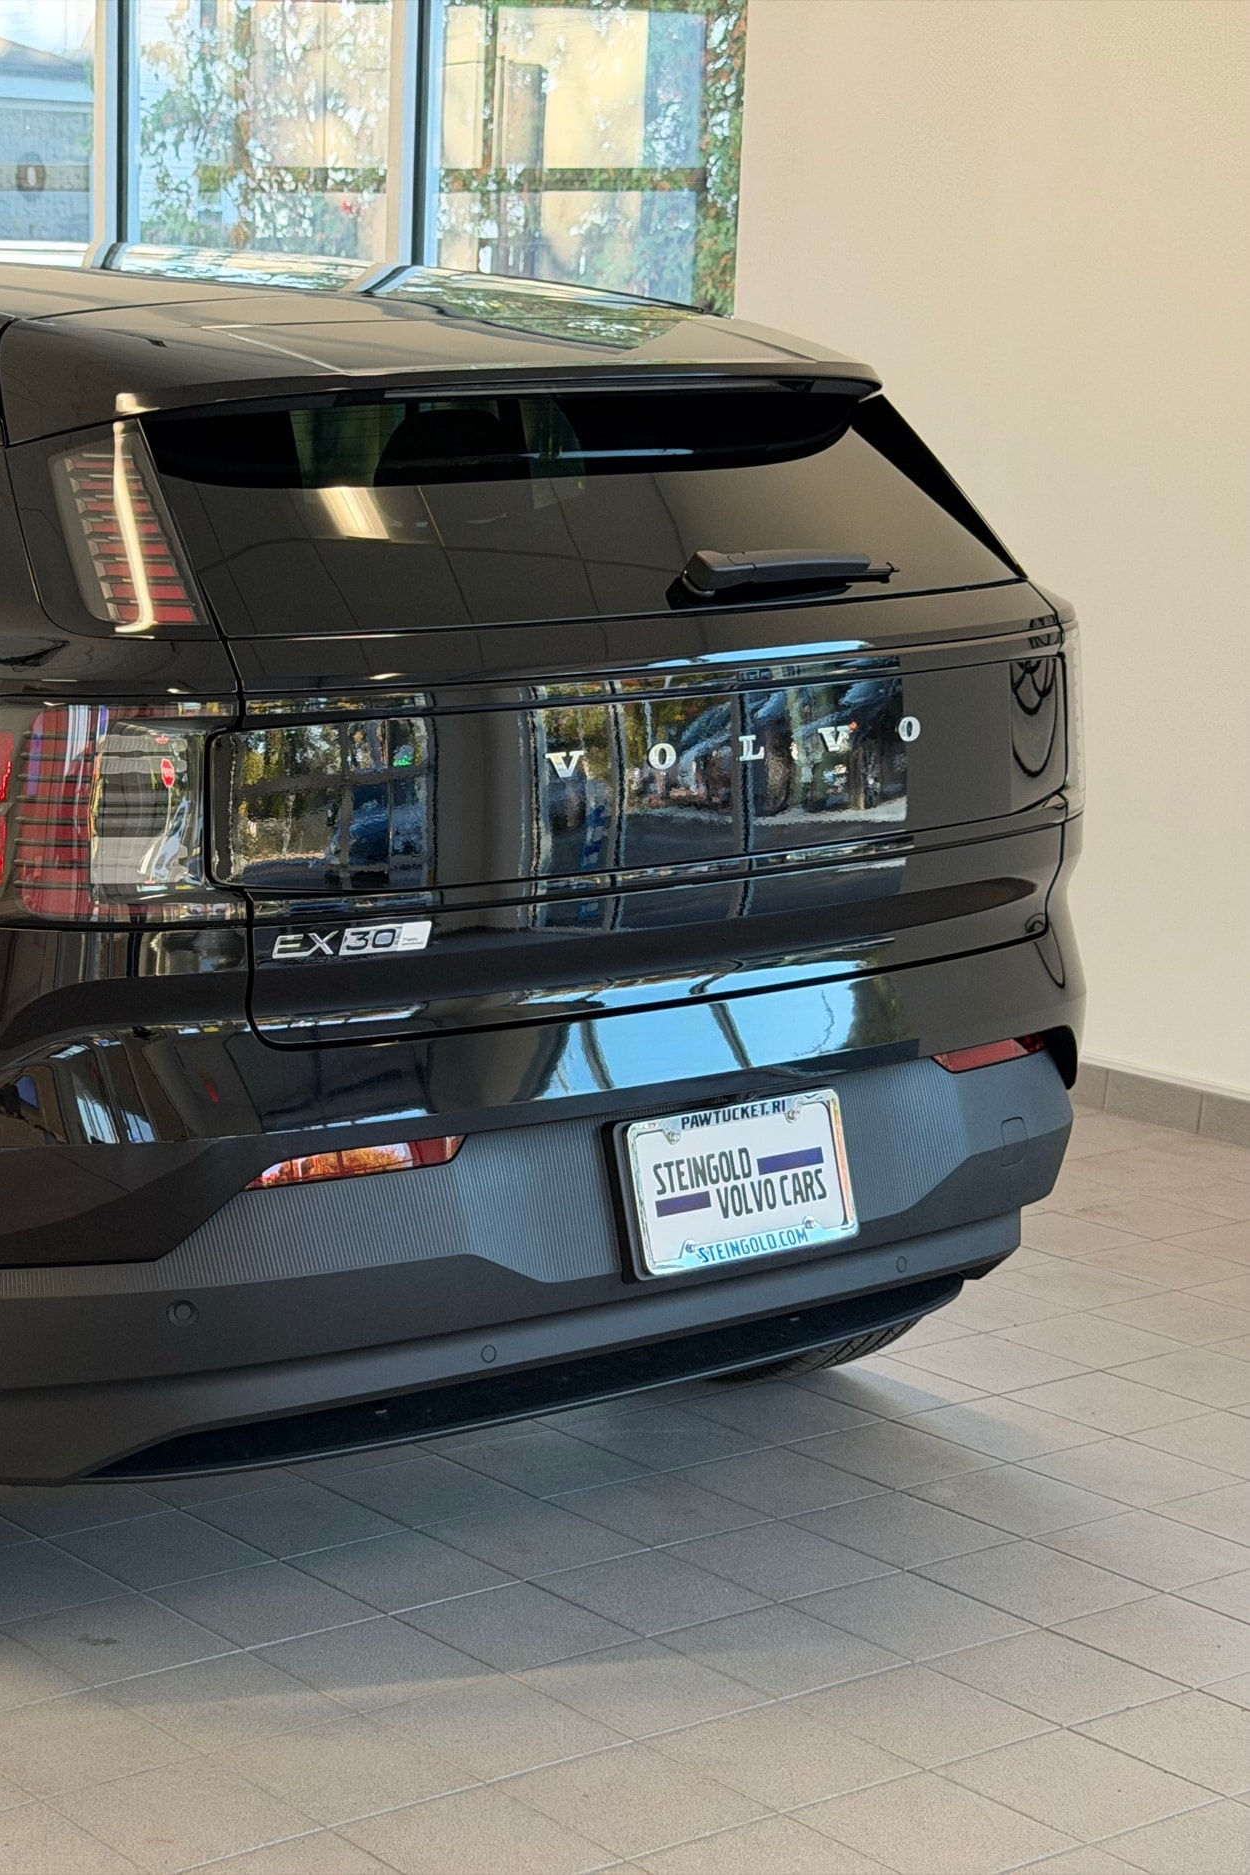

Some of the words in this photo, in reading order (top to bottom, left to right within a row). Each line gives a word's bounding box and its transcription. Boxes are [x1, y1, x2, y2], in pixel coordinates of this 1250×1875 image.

[545, 716, 921, 778] VOLVO
[772, 1099, 786, 1114] RI
[652, 1147, 752, 1195] STEINGOLD
[716, 1178, 777, 1219] VOLVO
[779, 1168, 827, 1206] CARS
[699, 1228, 809, 1264] STEINGOLD.COM
